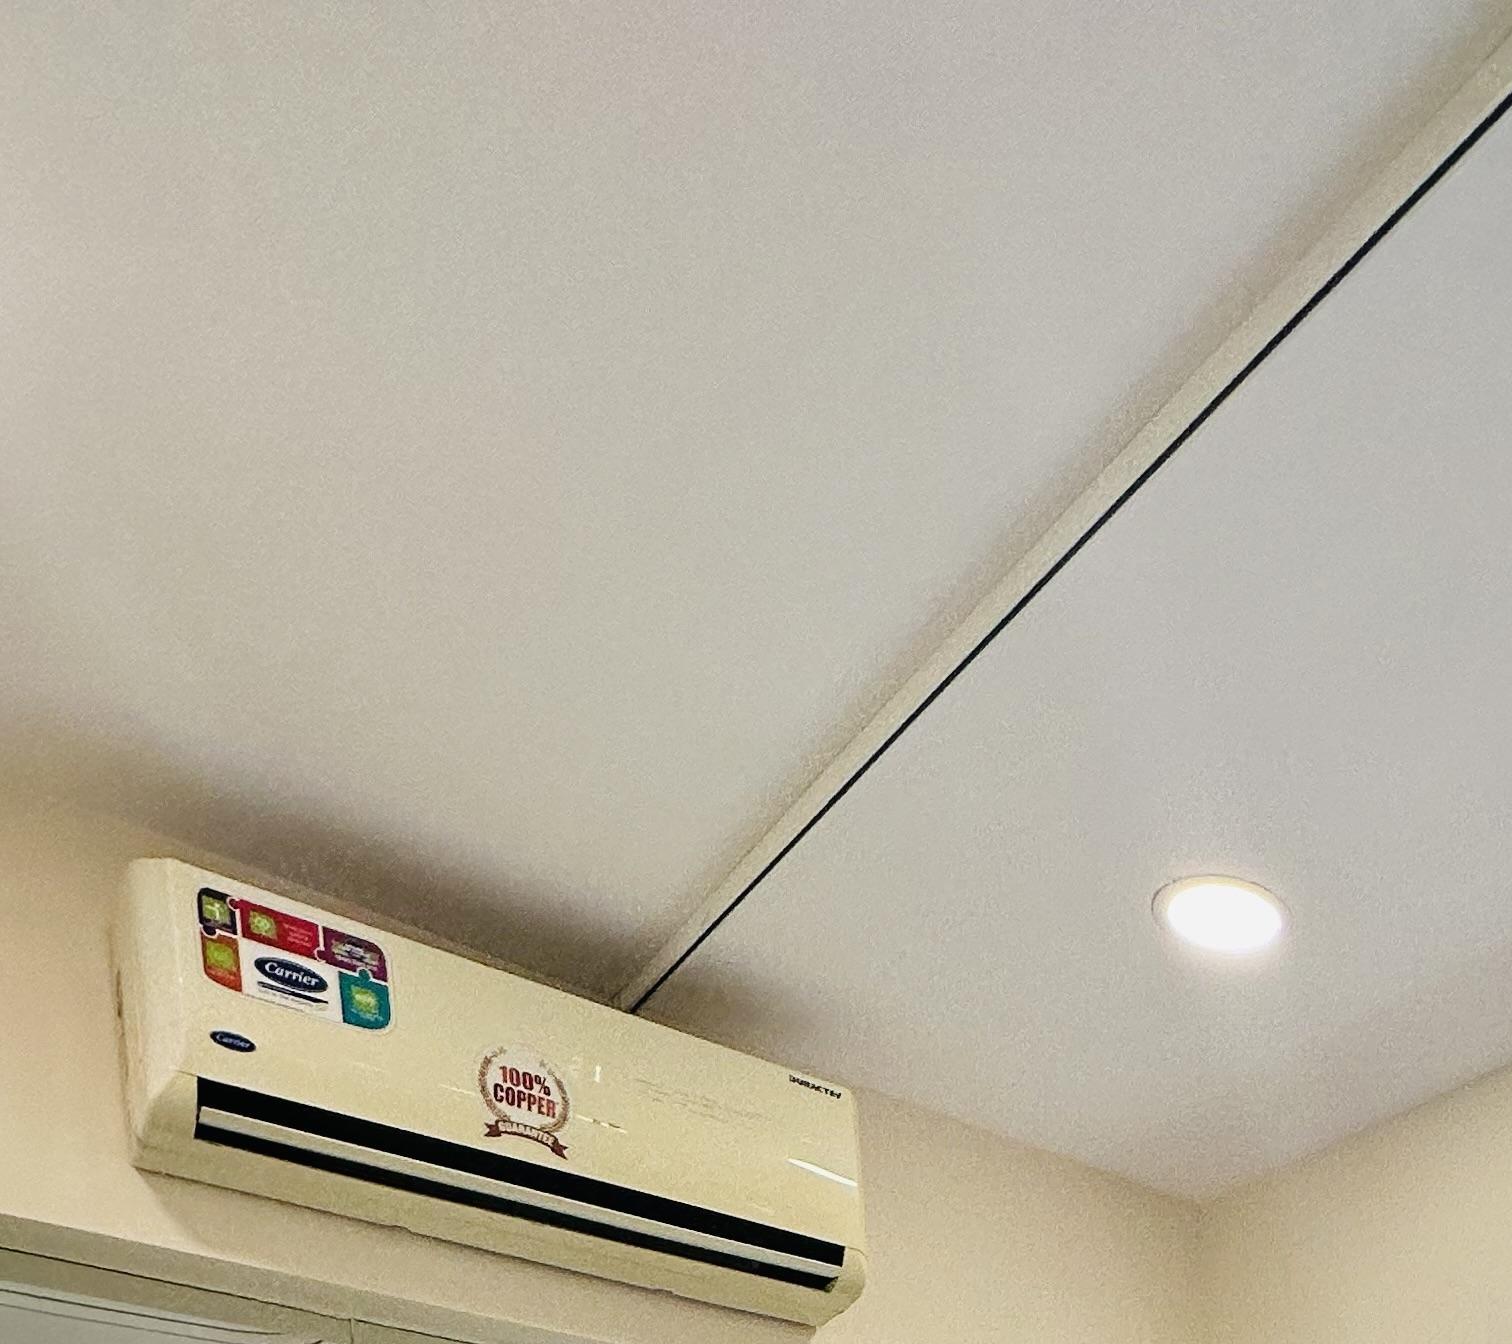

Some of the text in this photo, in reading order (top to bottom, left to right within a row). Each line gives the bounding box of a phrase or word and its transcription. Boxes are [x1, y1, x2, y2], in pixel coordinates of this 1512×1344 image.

[264, 961, 320, 987] Carrier
[216, 1031, 251, 1049] Carrier
[499, 1065, 551, 1097] 100%
[493, 1082, 556, 1119] COPPER
